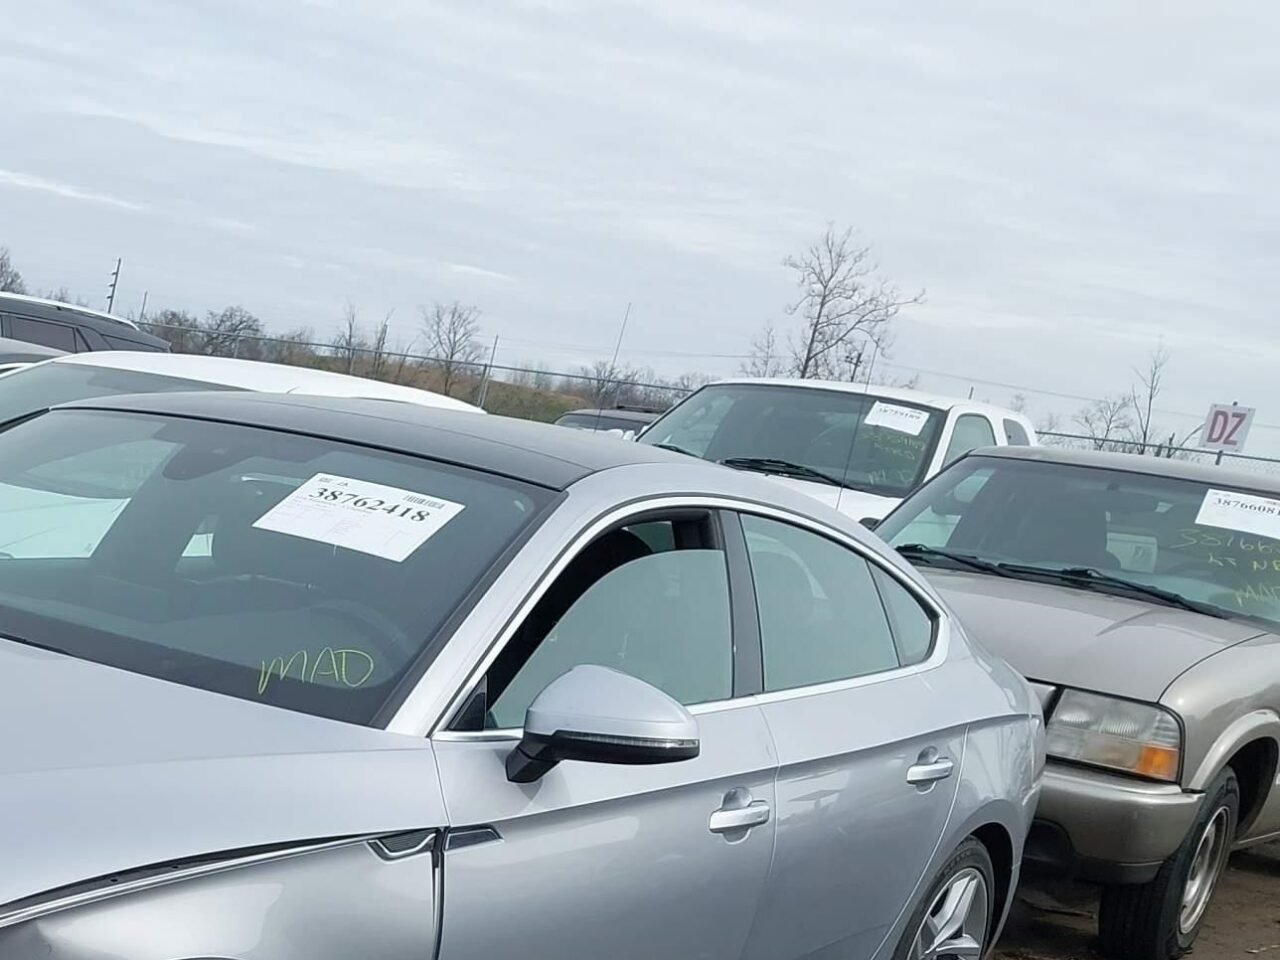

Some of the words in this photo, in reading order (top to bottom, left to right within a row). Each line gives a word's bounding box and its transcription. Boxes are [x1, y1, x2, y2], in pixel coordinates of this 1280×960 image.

[1206, 409, 1247, 446] DZ
[308, 487, 431, 522] 38762418
[257, 646, 375, 695] MAD
